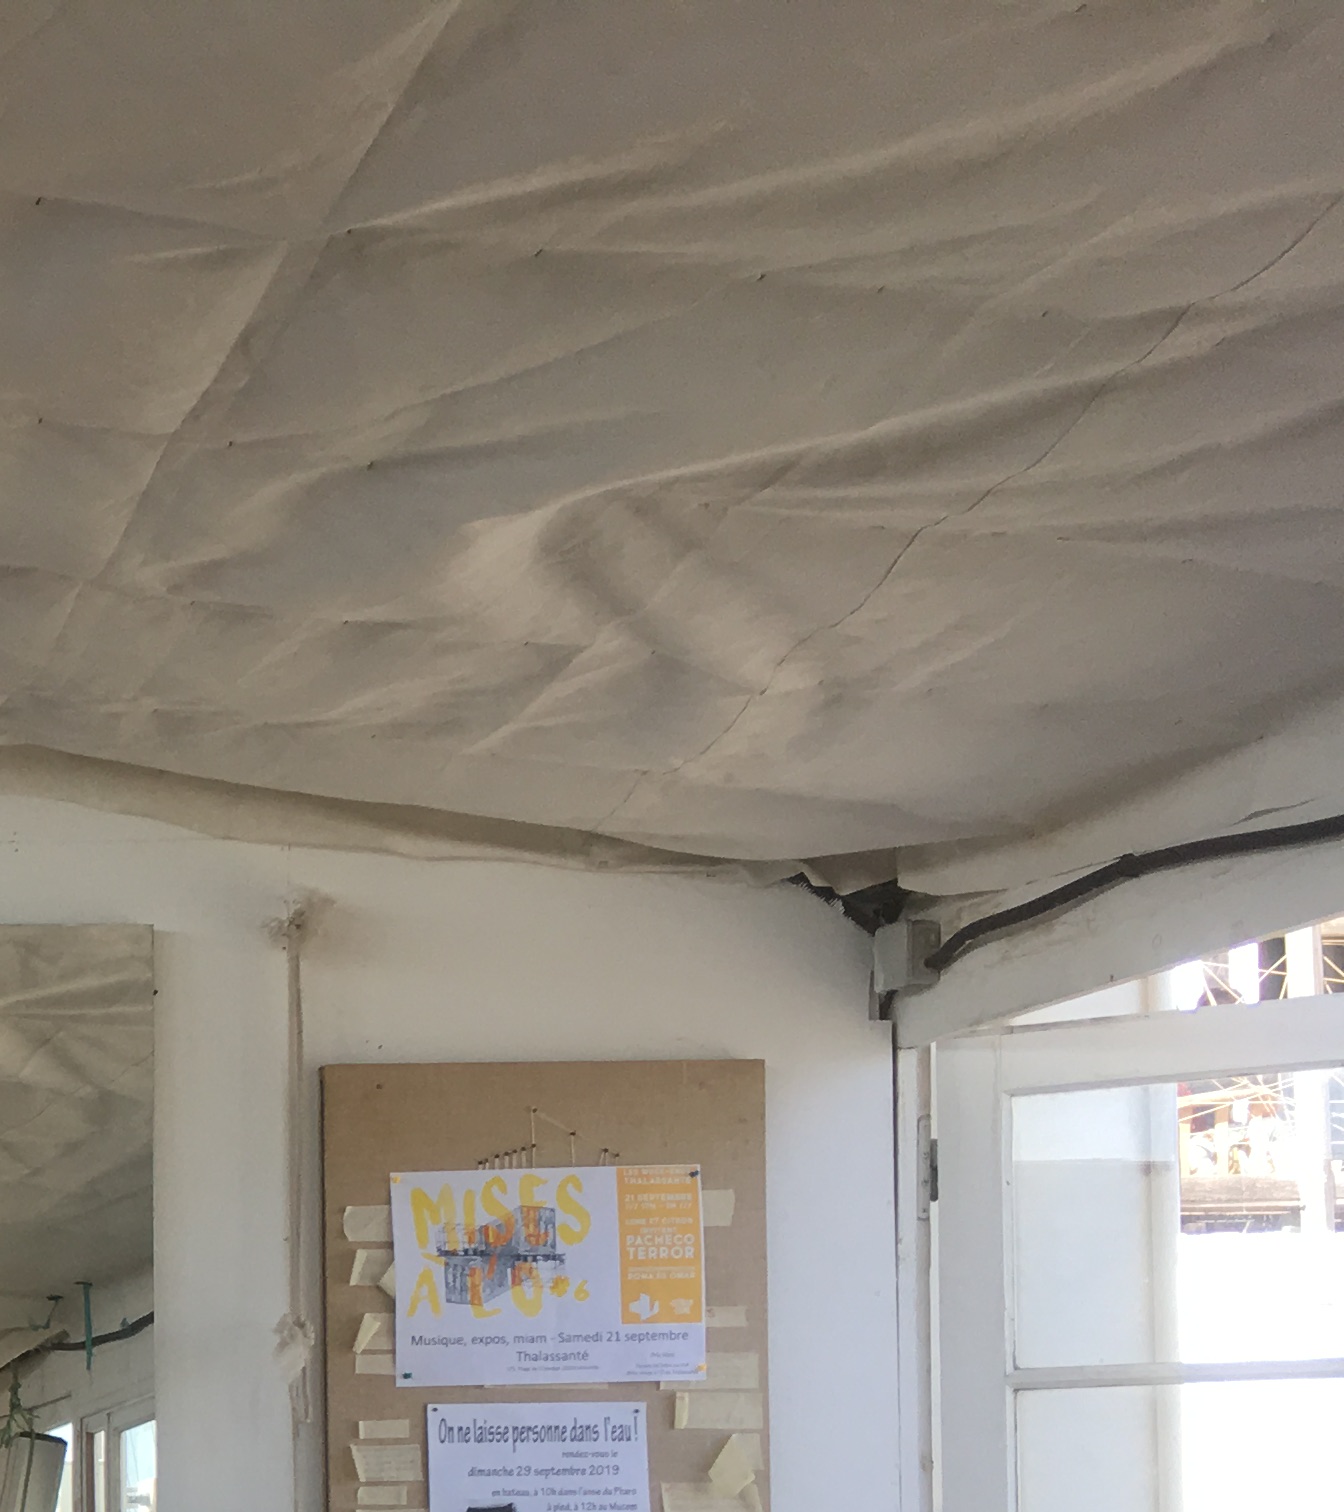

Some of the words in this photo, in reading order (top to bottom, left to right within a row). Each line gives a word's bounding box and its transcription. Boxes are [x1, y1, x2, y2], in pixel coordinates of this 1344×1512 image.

[410, 1173, 591, 1250] MISES
[626, 1234, 695, 1246] PACHECO
[627, 1247, 695, 1260] TERROR
[411, 1334, 467, 1348] Musique,
[471, 1334, 509, 1348] expos,
[513, 1333, 547, 1344] miam
[558, 1331, 603, 1344] Samedi
[607, 1331, 621, 1342] 21
[625, 1330, 688, 1344] septembre
[516, 1350, 589, 1362] Thalassanté
[438, 1418, 454, 1444] On
[457, 1425, 471, 1443] ne
[473, 1418, 509, 1444] laisse
[511, 1424, 567, 1453] personne
[569, 1418, 599, 1443] dans
[468, 1466, 514, 1477] dimanche
[516, 1466, 532, 1477] 29
[534, 1465, 586, 1479] septembre
[588, 1465, 620, 1476] 2019
[582, 1503, 597, 1511] 12h
